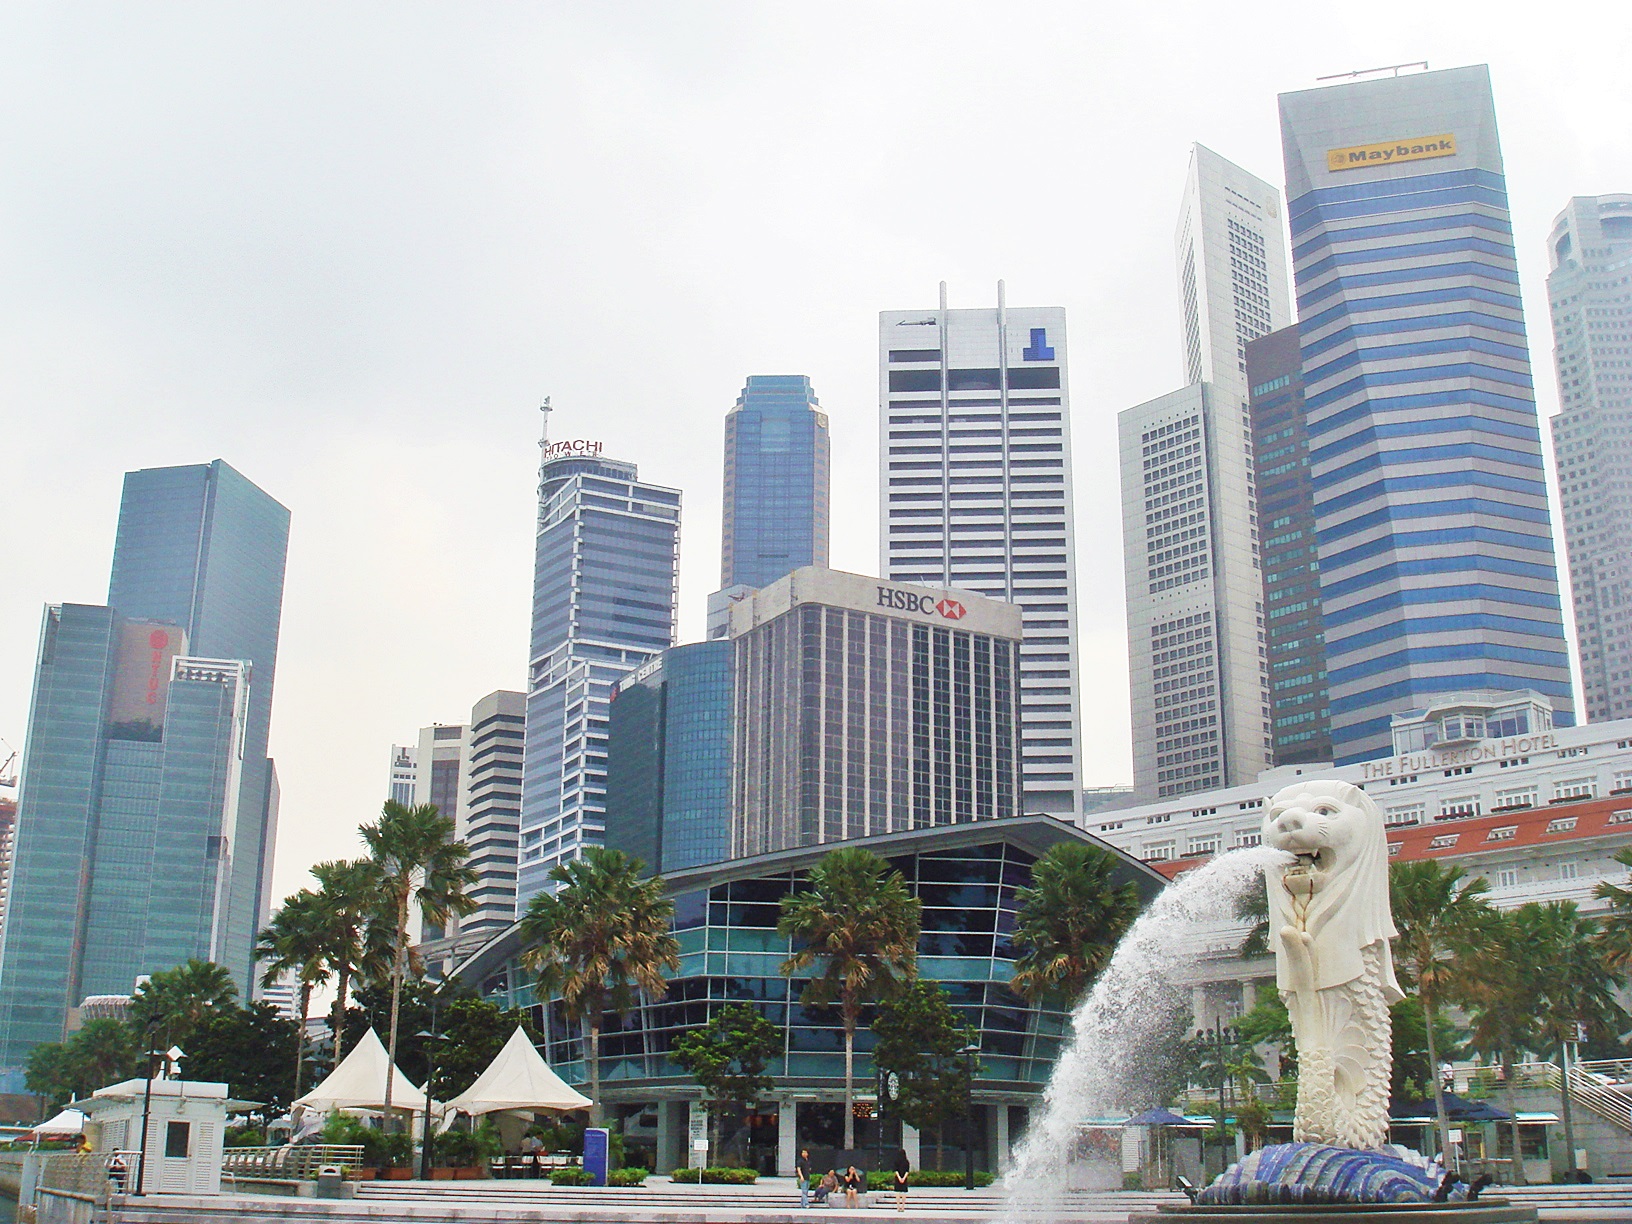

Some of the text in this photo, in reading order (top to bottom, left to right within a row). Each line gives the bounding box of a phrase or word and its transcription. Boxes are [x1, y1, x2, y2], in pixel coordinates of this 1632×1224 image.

[1348, 140, 1452, 161] Maybank
[544, 439, 603, 459] HITACHI
[876, 586, 935, 615] HSBC
[1360, 734, 1559, 779] THE FULLERTON HOTEL
